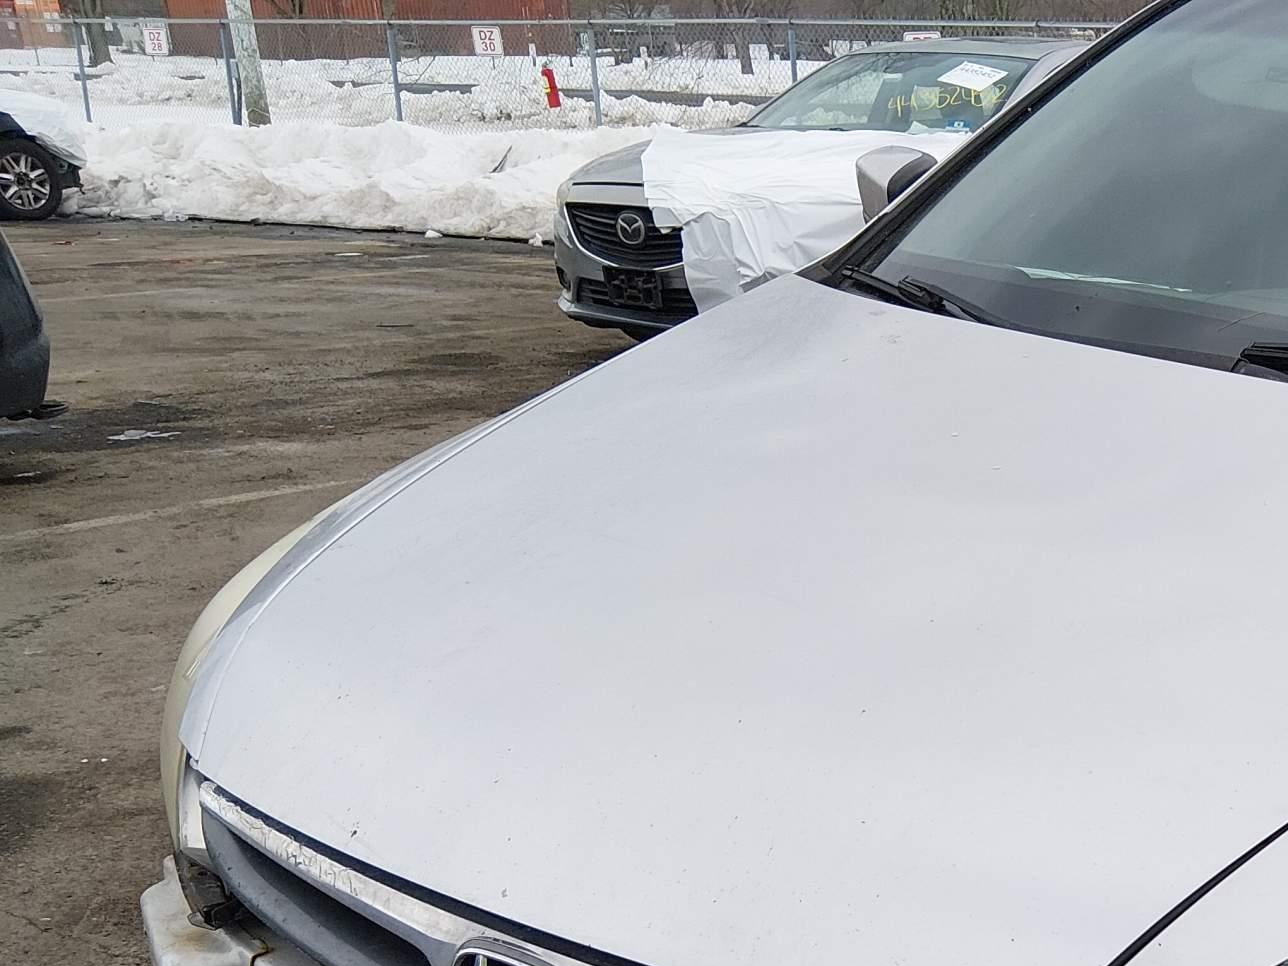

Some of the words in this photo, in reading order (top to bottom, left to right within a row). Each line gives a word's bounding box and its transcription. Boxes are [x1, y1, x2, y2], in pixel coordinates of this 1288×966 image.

[148, 31, 161, 42] DZ
[479, 30, 495, 41] DZ
[151, 42, 163, 52] 28
[481, 41, 496, 52] 30
